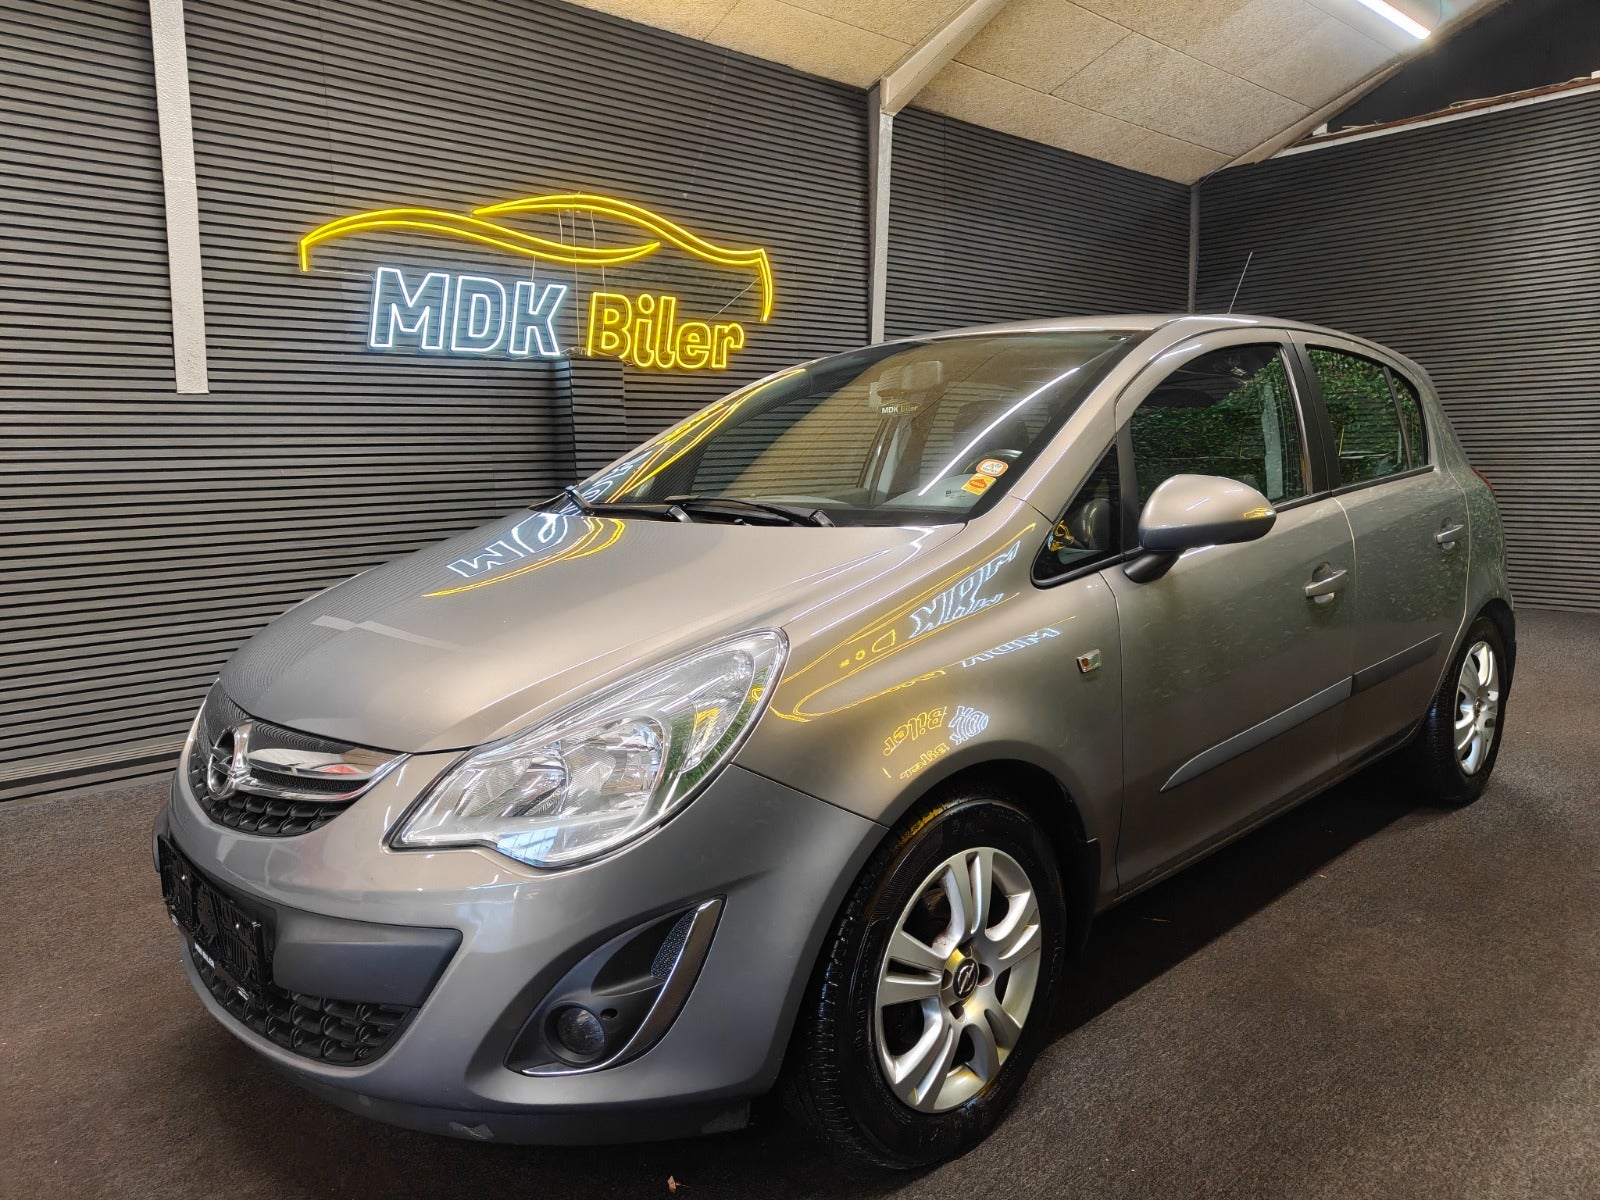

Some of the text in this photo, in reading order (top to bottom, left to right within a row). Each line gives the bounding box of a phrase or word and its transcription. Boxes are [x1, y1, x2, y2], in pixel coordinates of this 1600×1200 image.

[367, 266, 746, 370] MDK Biler
[881, 405, 899, 414] MDK
